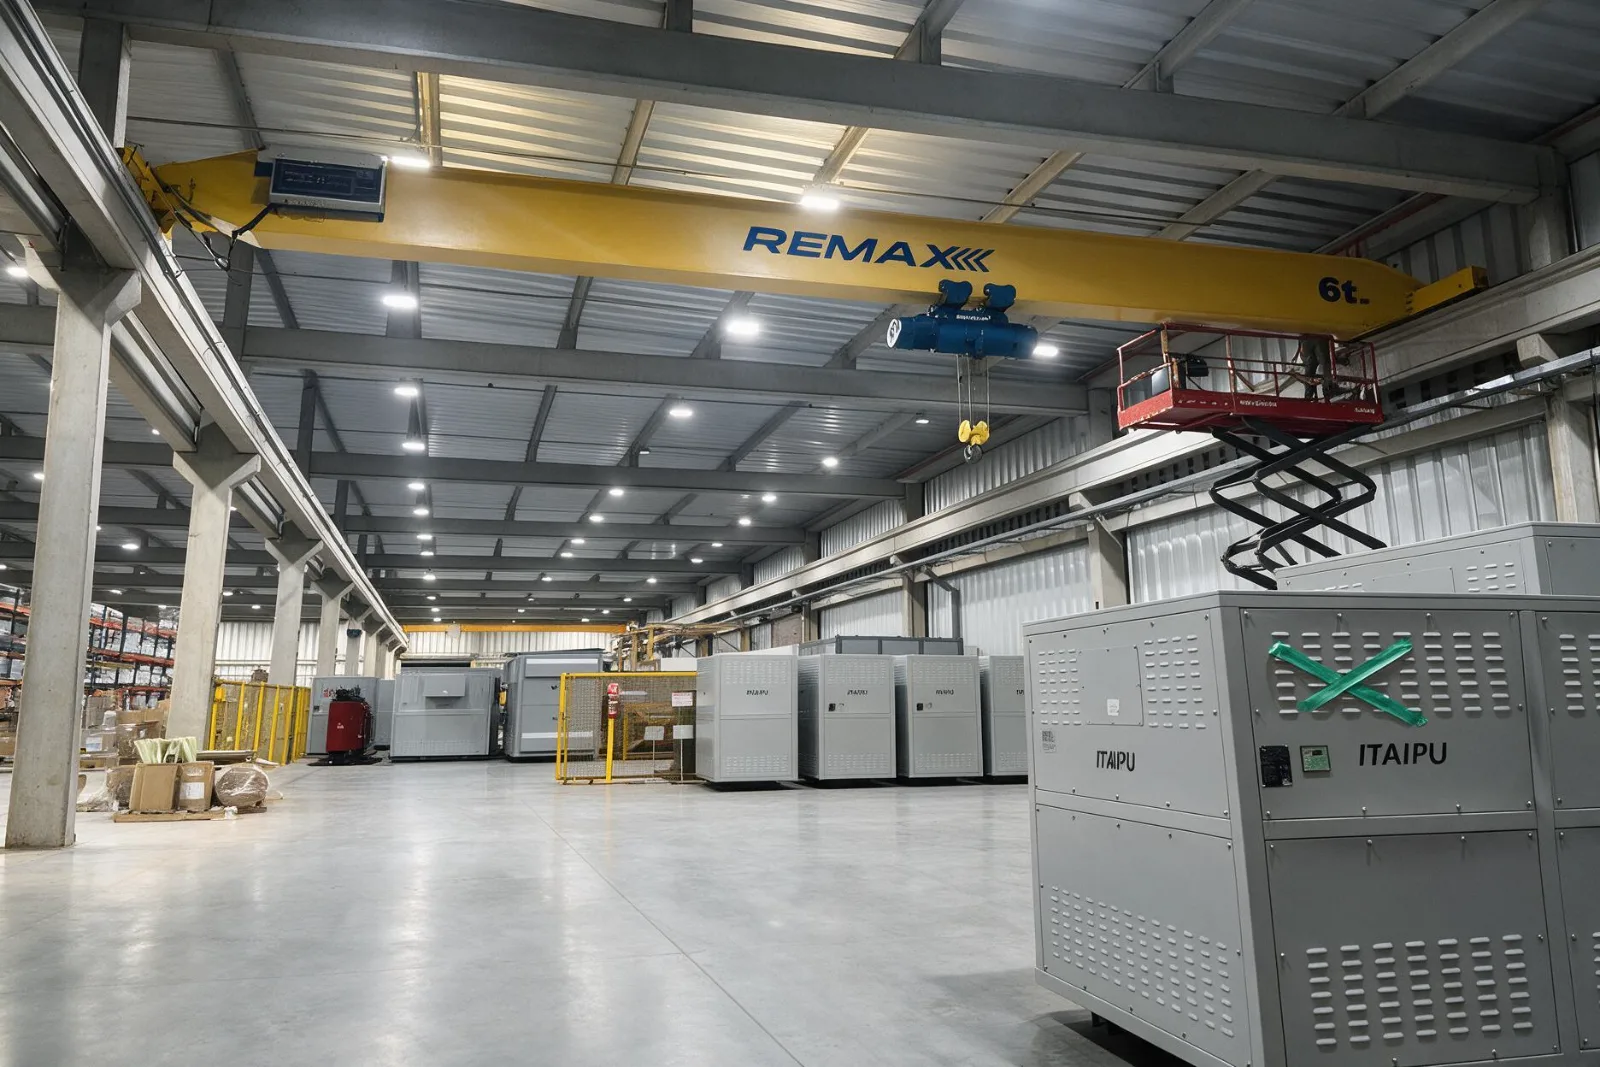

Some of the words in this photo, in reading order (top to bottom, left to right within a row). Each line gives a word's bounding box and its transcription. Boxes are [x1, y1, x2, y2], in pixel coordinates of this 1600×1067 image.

[743, 226, 961, 271] REMAX
[1096, 750, 1136, 772] ITAIPU
[1359, 742, 1447, 766] ITAIPU
